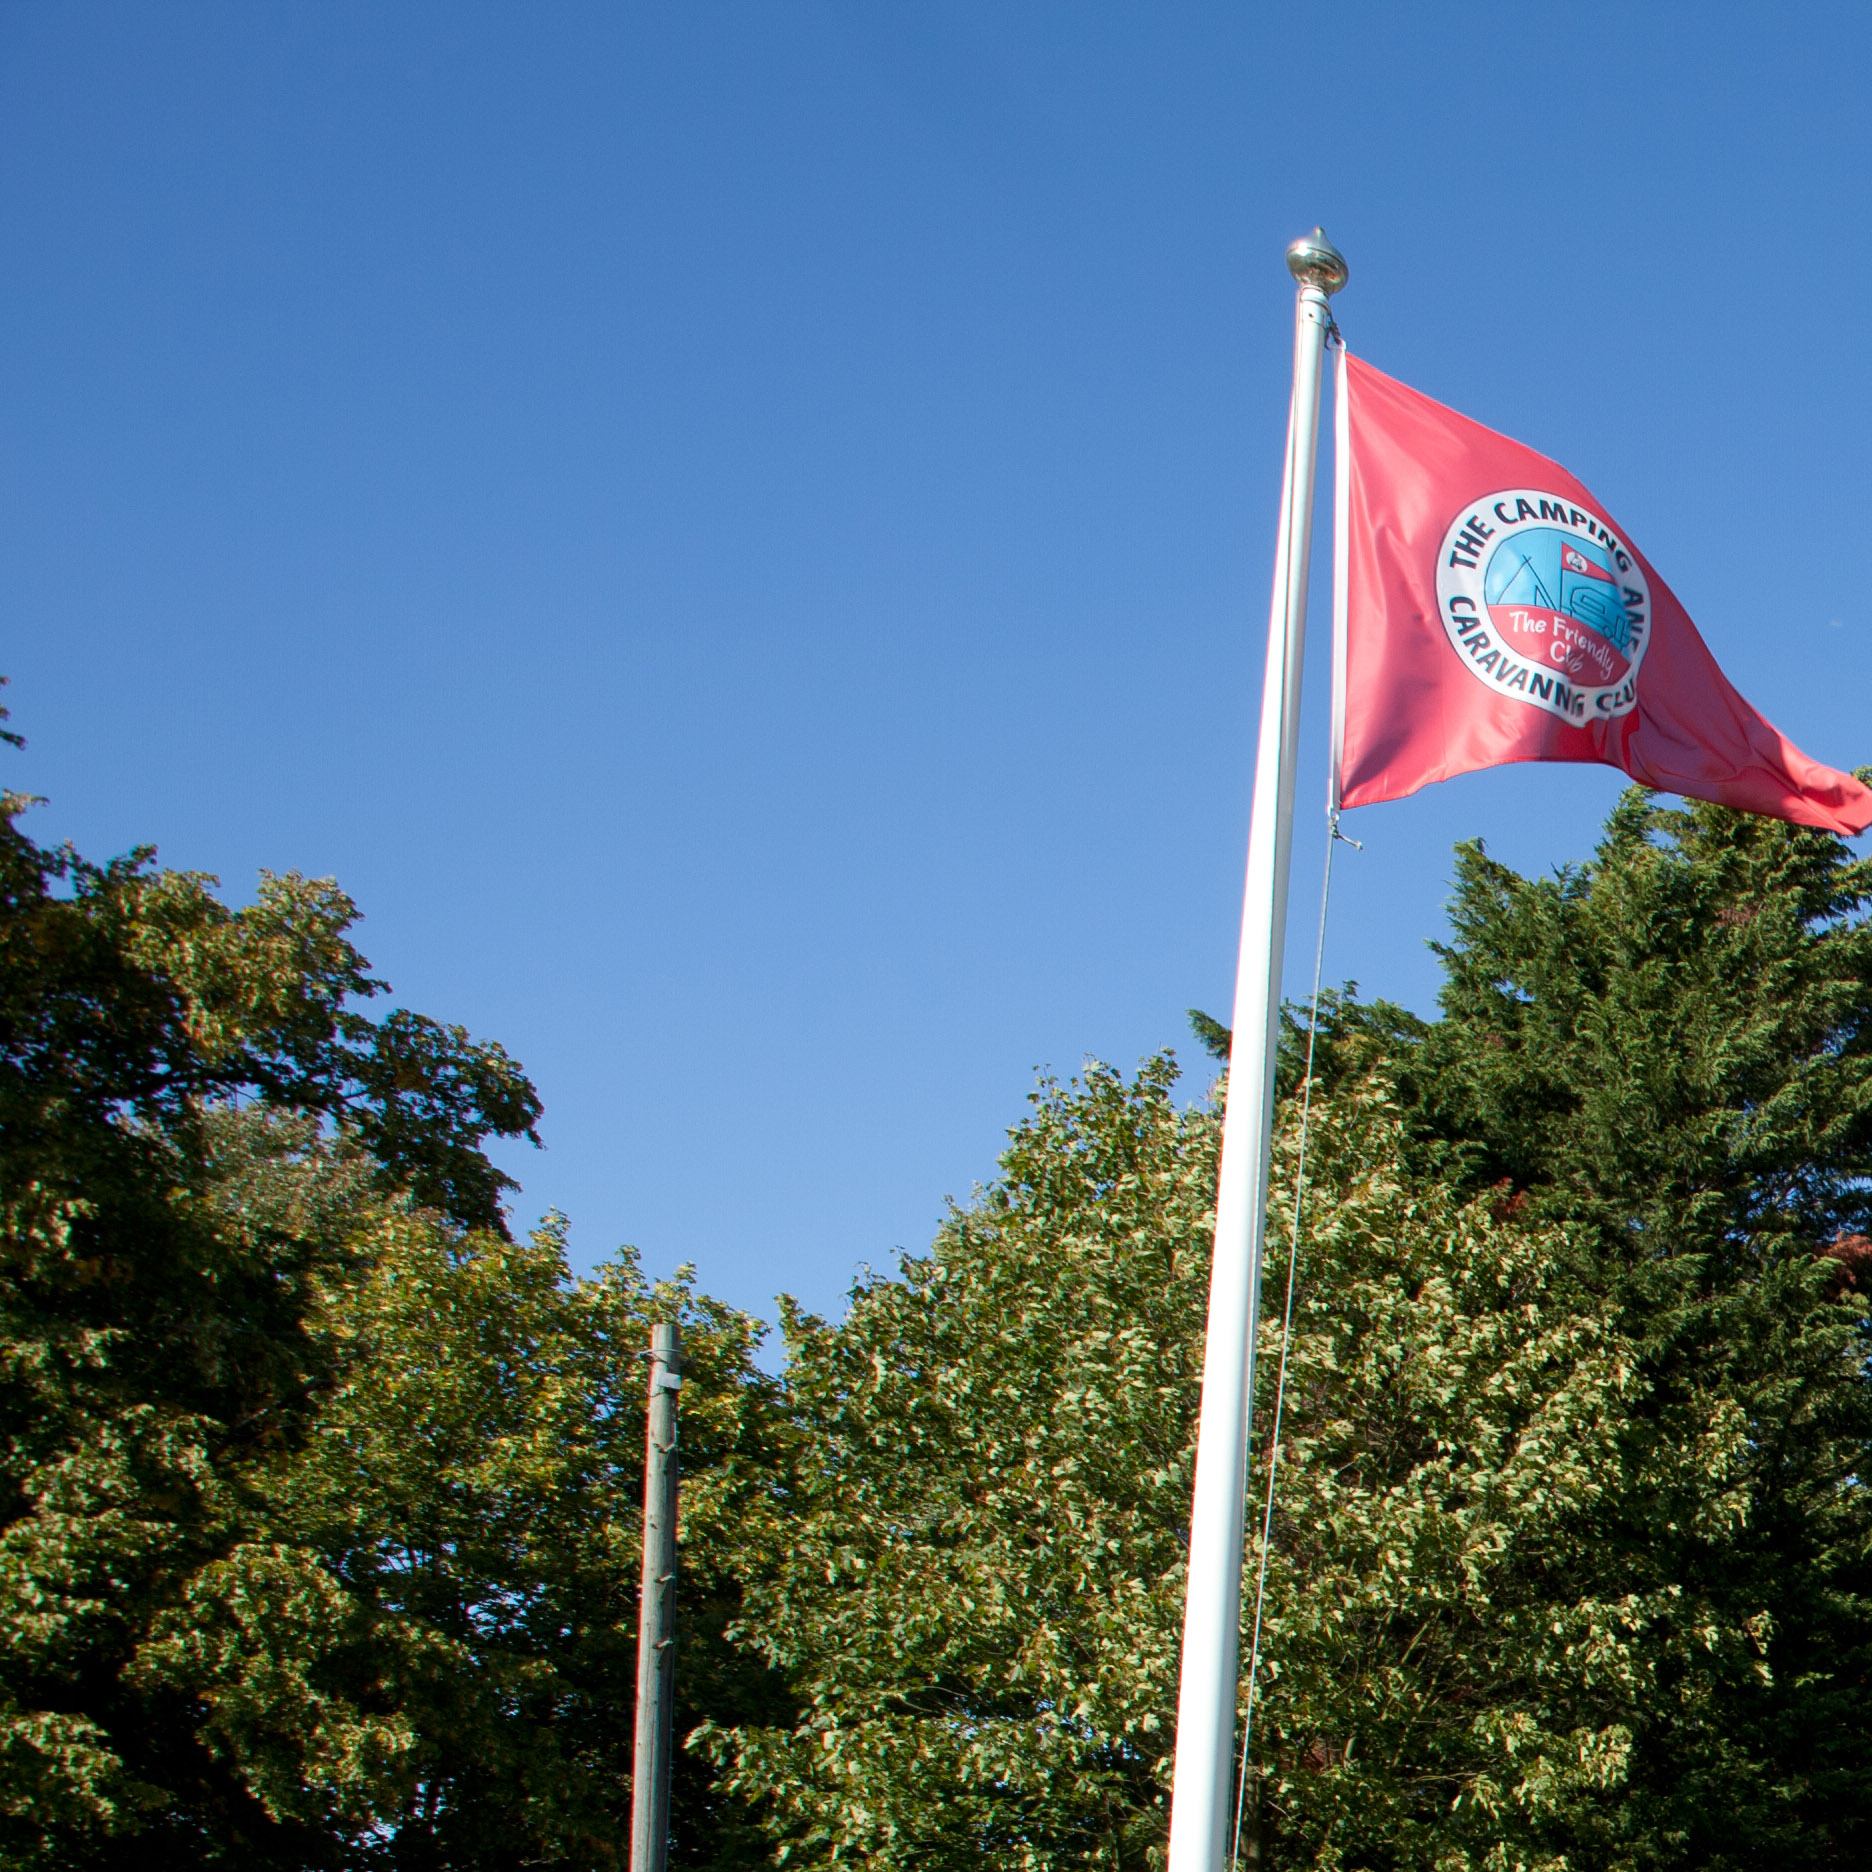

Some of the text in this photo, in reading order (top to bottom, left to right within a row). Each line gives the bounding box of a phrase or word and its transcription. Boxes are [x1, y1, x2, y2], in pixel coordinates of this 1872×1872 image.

[1450, 515, 1495, 570] THE
[1493, 498, 1633, 573] CAMPING
[1509, 611, 1614, 681] The Friendly
[1550, 640, 1584, 673] Club
[1596, 677, 1634, 712] CLU
